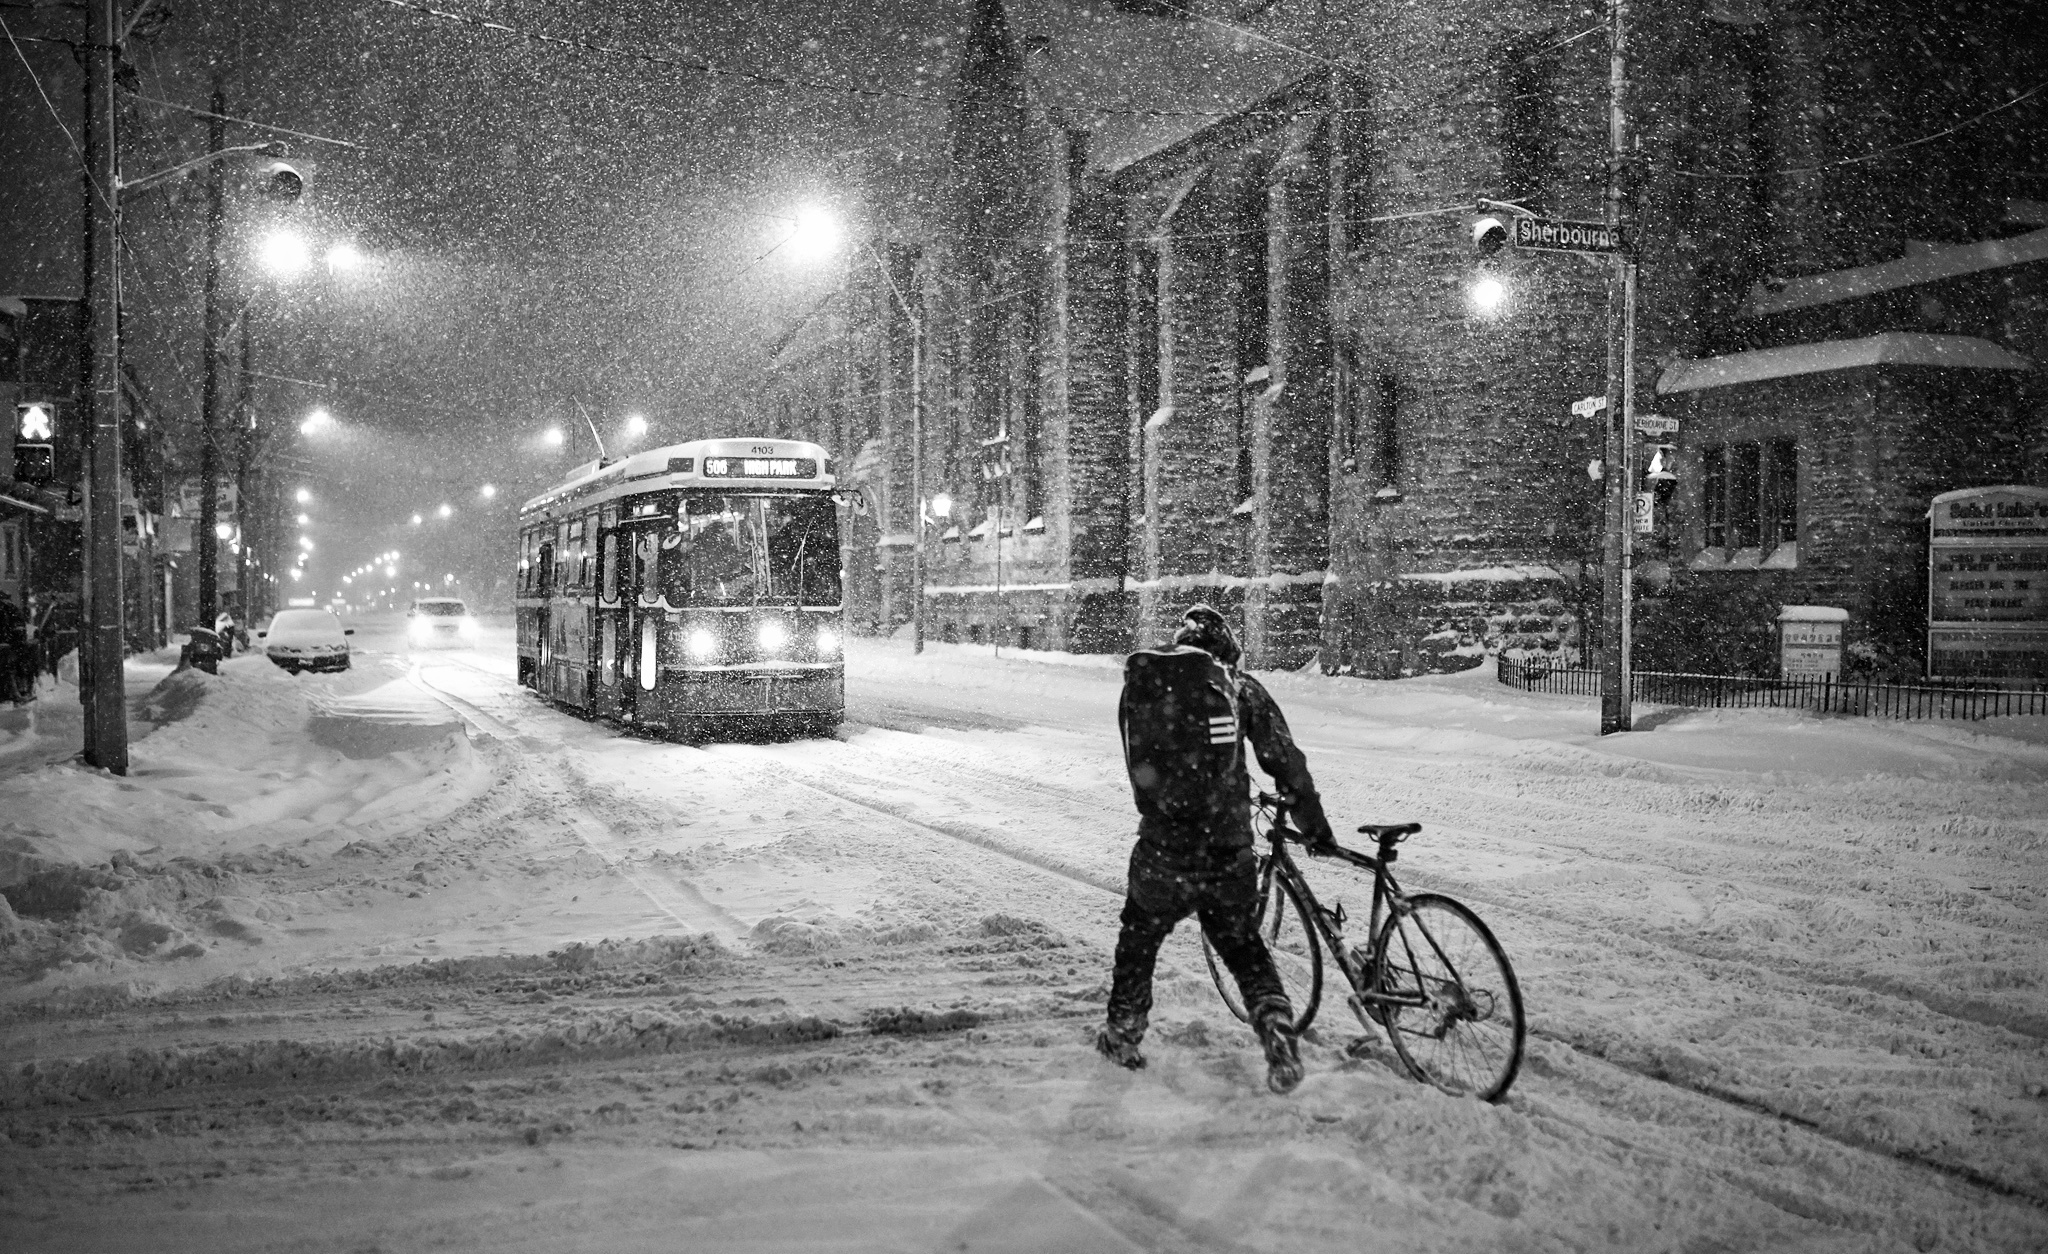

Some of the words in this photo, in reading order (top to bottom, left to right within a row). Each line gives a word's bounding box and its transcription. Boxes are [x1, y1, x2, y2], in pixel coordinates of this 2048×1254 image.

[1520, 220, 1620, 248] Sherbourne
[1573, 400, 1596, 412] CARLTON
[751, 446, 774, 455] 4103
[706, 459, 728, 475] 506
[744, 459, 769, 476] HIGH
[770, 459, 797, 476] PARK
